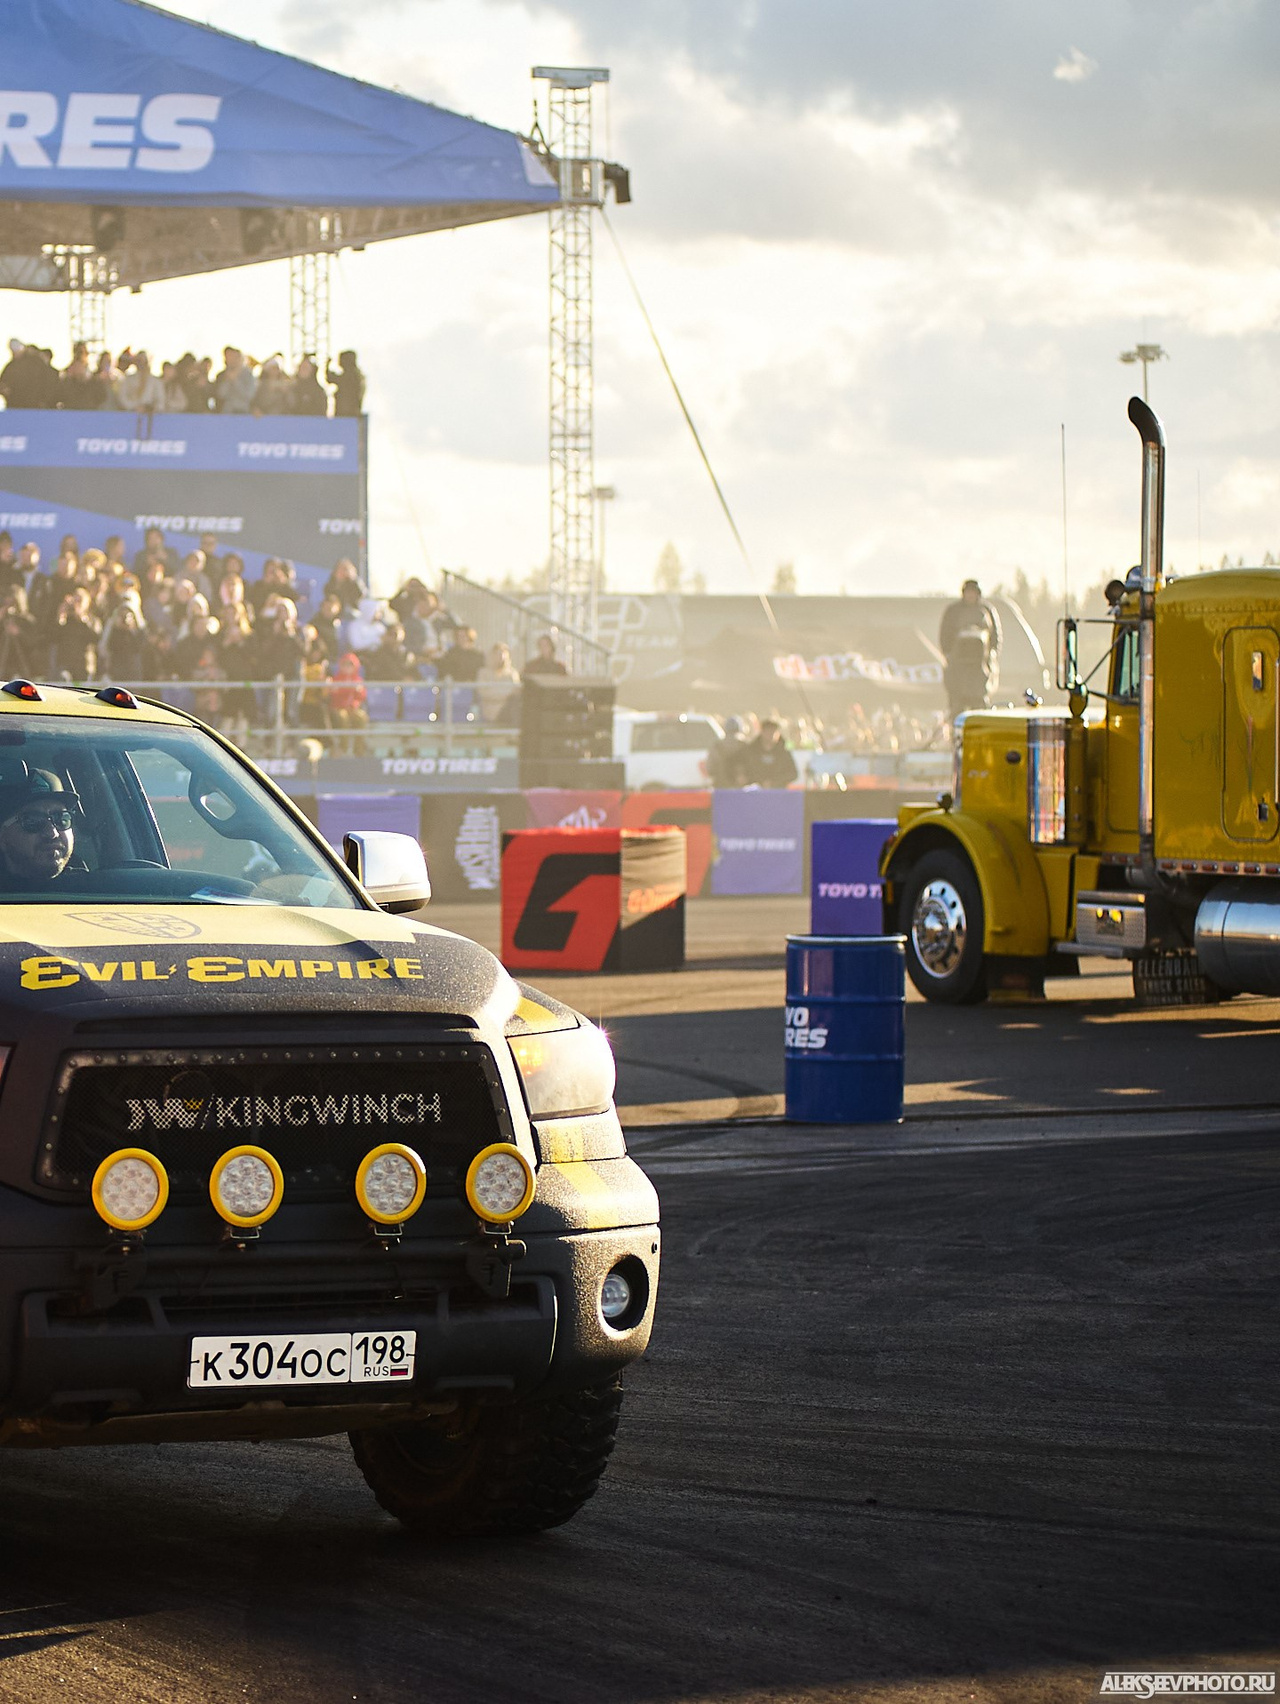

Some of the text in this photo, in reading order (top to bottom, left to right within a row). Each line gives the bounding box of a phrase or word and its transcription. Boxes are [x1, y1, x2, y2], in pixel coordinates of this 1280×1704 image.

[77, 438, 186, 455] TOYO TIRES
[238, 442, 345, 460] TOYO TIRES
[187, 516, 243, 532] TIRES
[381, 758, 498, 774] TOYO TIRES
[818, 883, 868, 898] TOYO
[20, 955, 424, 990] EVIL EMPIRE
[355, 1335, 406, 1366] 198
[364, 1365, 389, 1377] RUS
